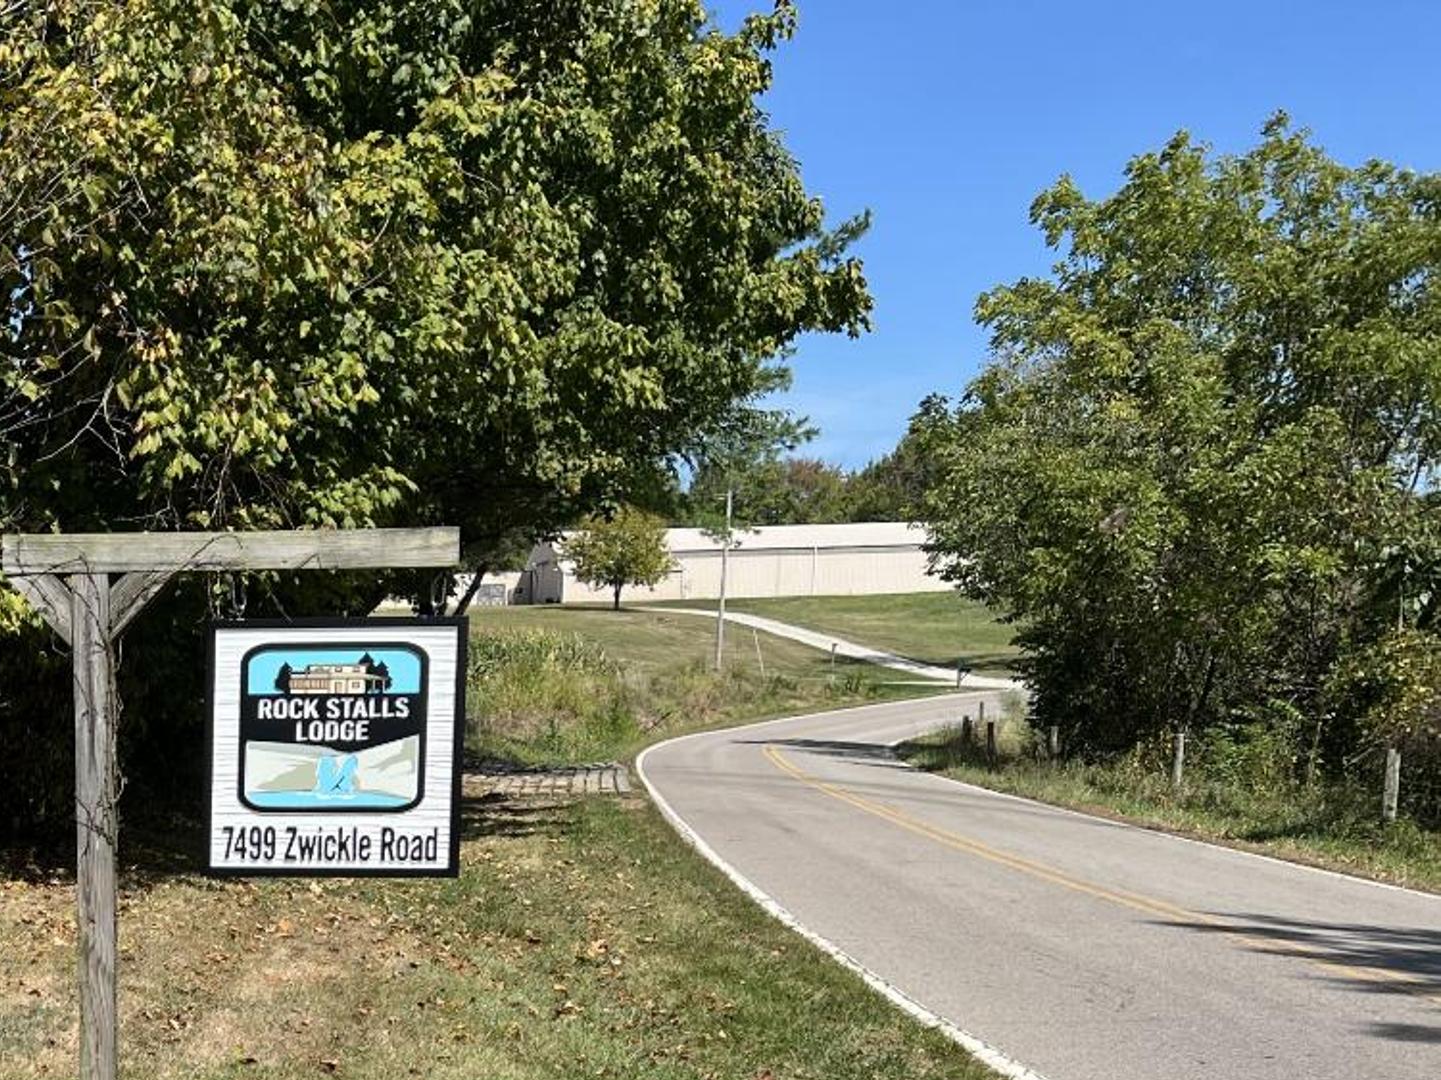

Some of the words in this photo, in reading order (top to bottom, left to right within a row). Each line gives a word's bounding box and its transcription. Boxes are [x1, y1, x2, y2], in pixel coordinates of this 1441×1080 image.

[257, 698, 320, 720] ROCK
[326, 697, 410, 719] STALLS
[296, 720, 370, 741] LODGE
[222, 826, 277, 860] 7499
[284, 826, 372, 861] Zwickle
[380, 826, 438, 862] Road
